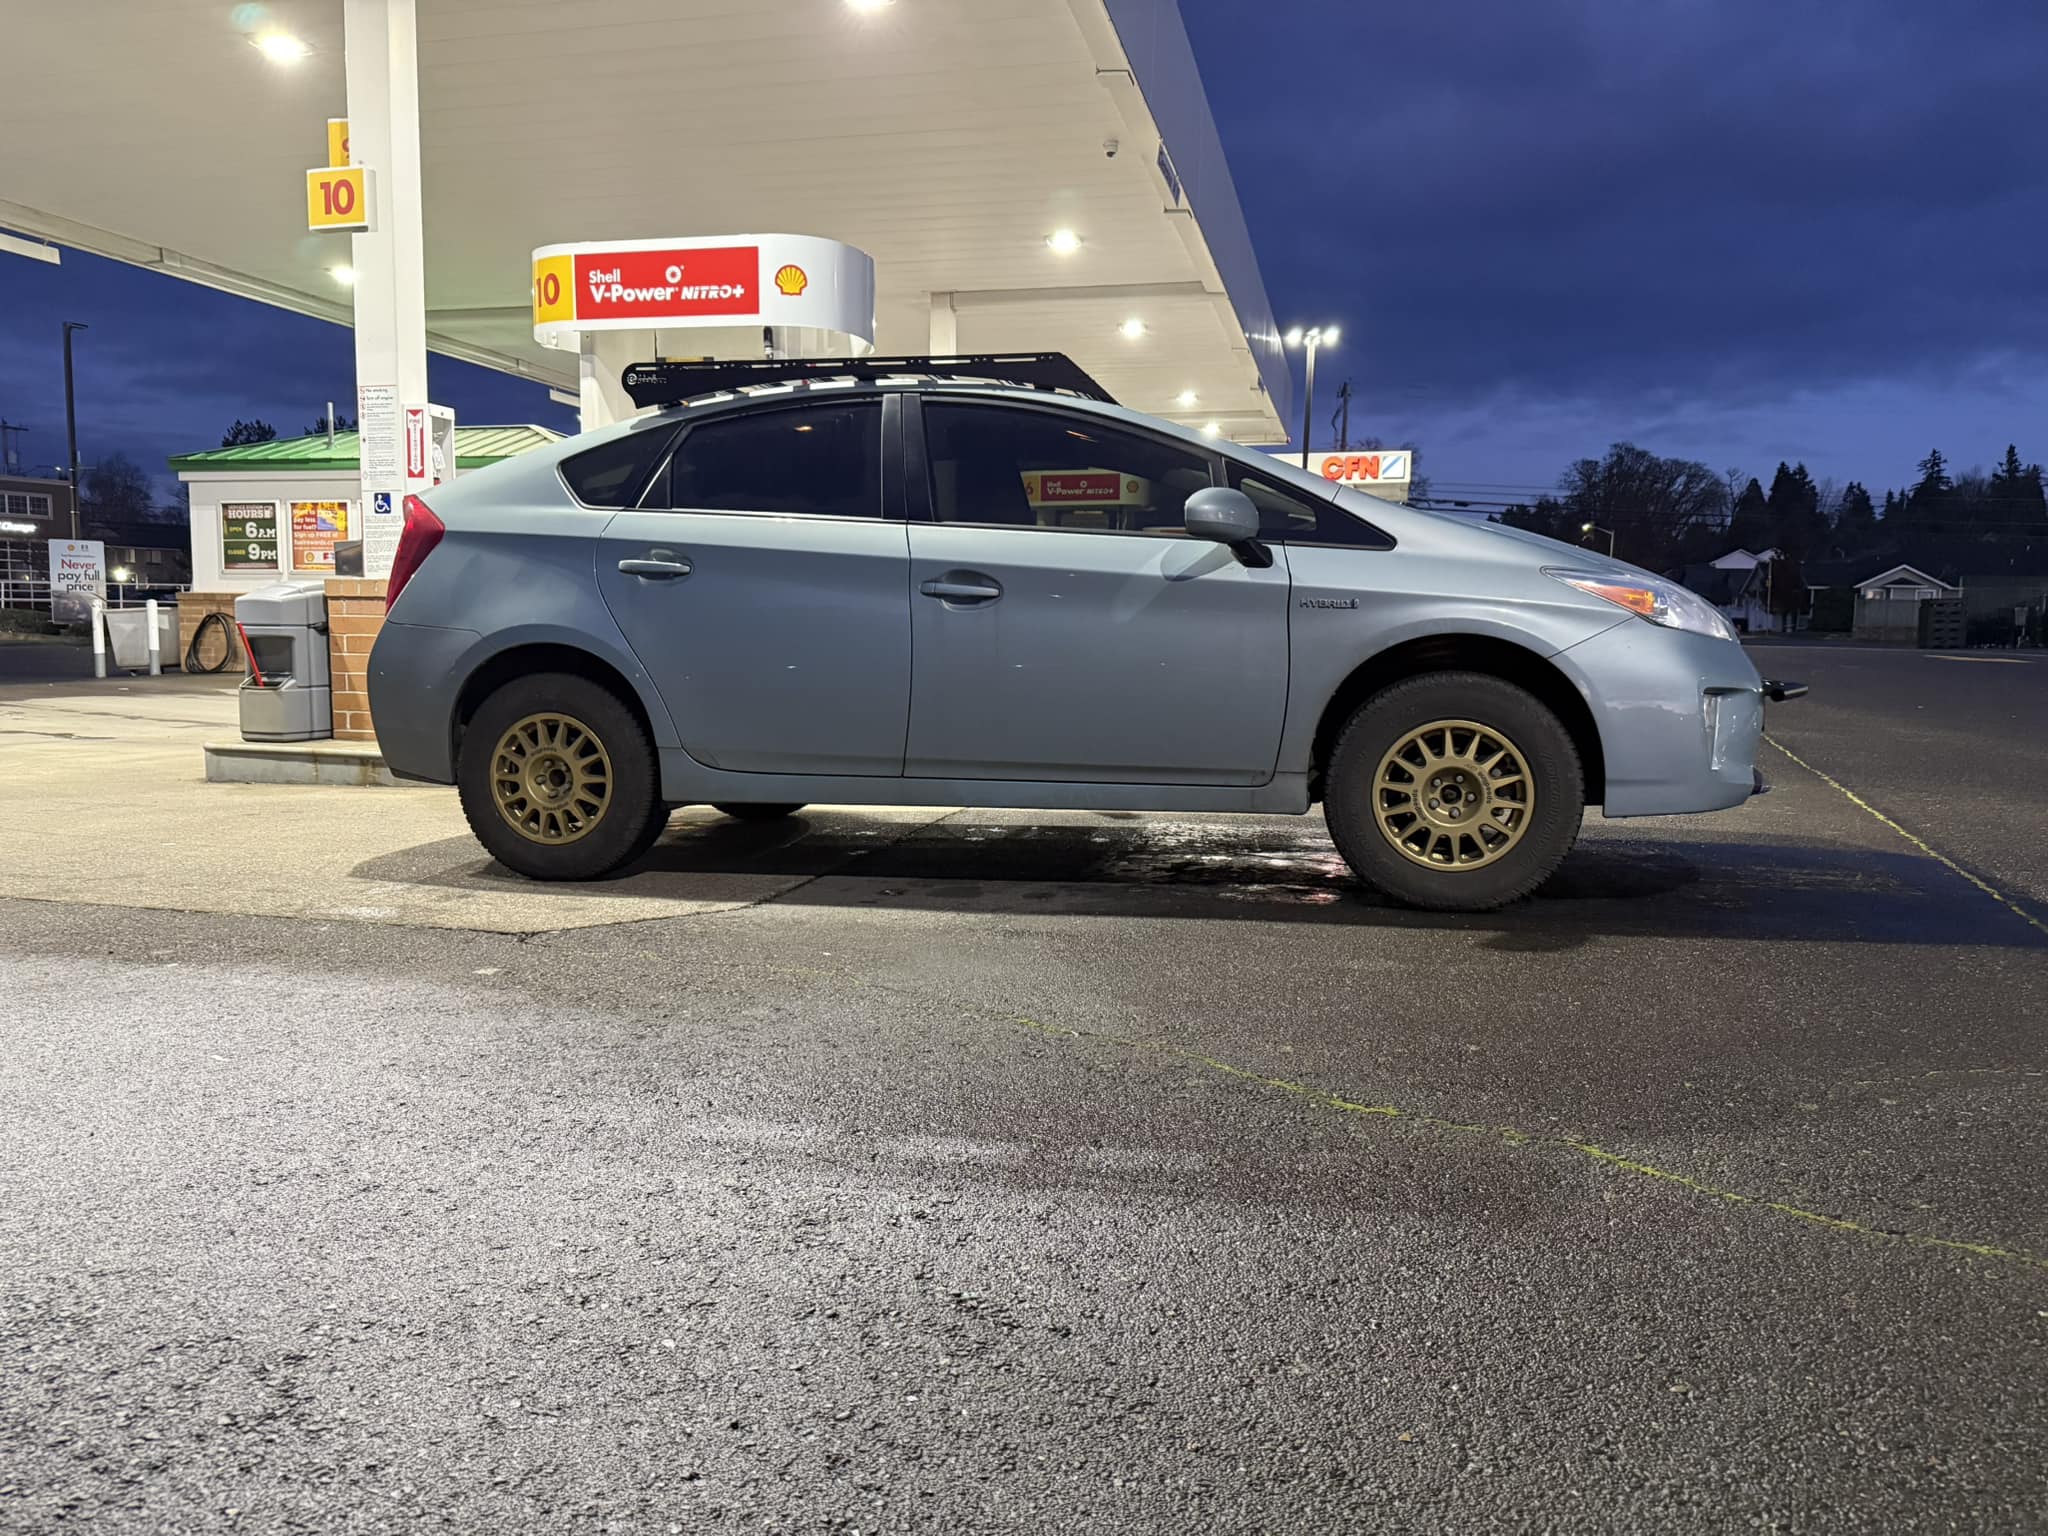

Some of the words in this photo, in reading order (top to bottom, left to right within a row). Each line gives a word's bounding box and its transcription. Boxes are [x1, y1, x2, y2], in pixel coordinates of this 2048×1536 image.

[320, 179, 355, 215] 10
[588, 268, 621, 284] Shell
[536, 272, 560, 308] 10
[589, 284, 675, 304] V-Power
[1321, 456, 1380, 480] CFN
[228, 510, 264, 519] HOURS
[61, 559, 96, 570] Never
[58, 572, 81, 583] pay
[84, 569, 100, 581] full
[66, 580, 94, 593] price
[1299, 599, 1351, 609] HYBRID
